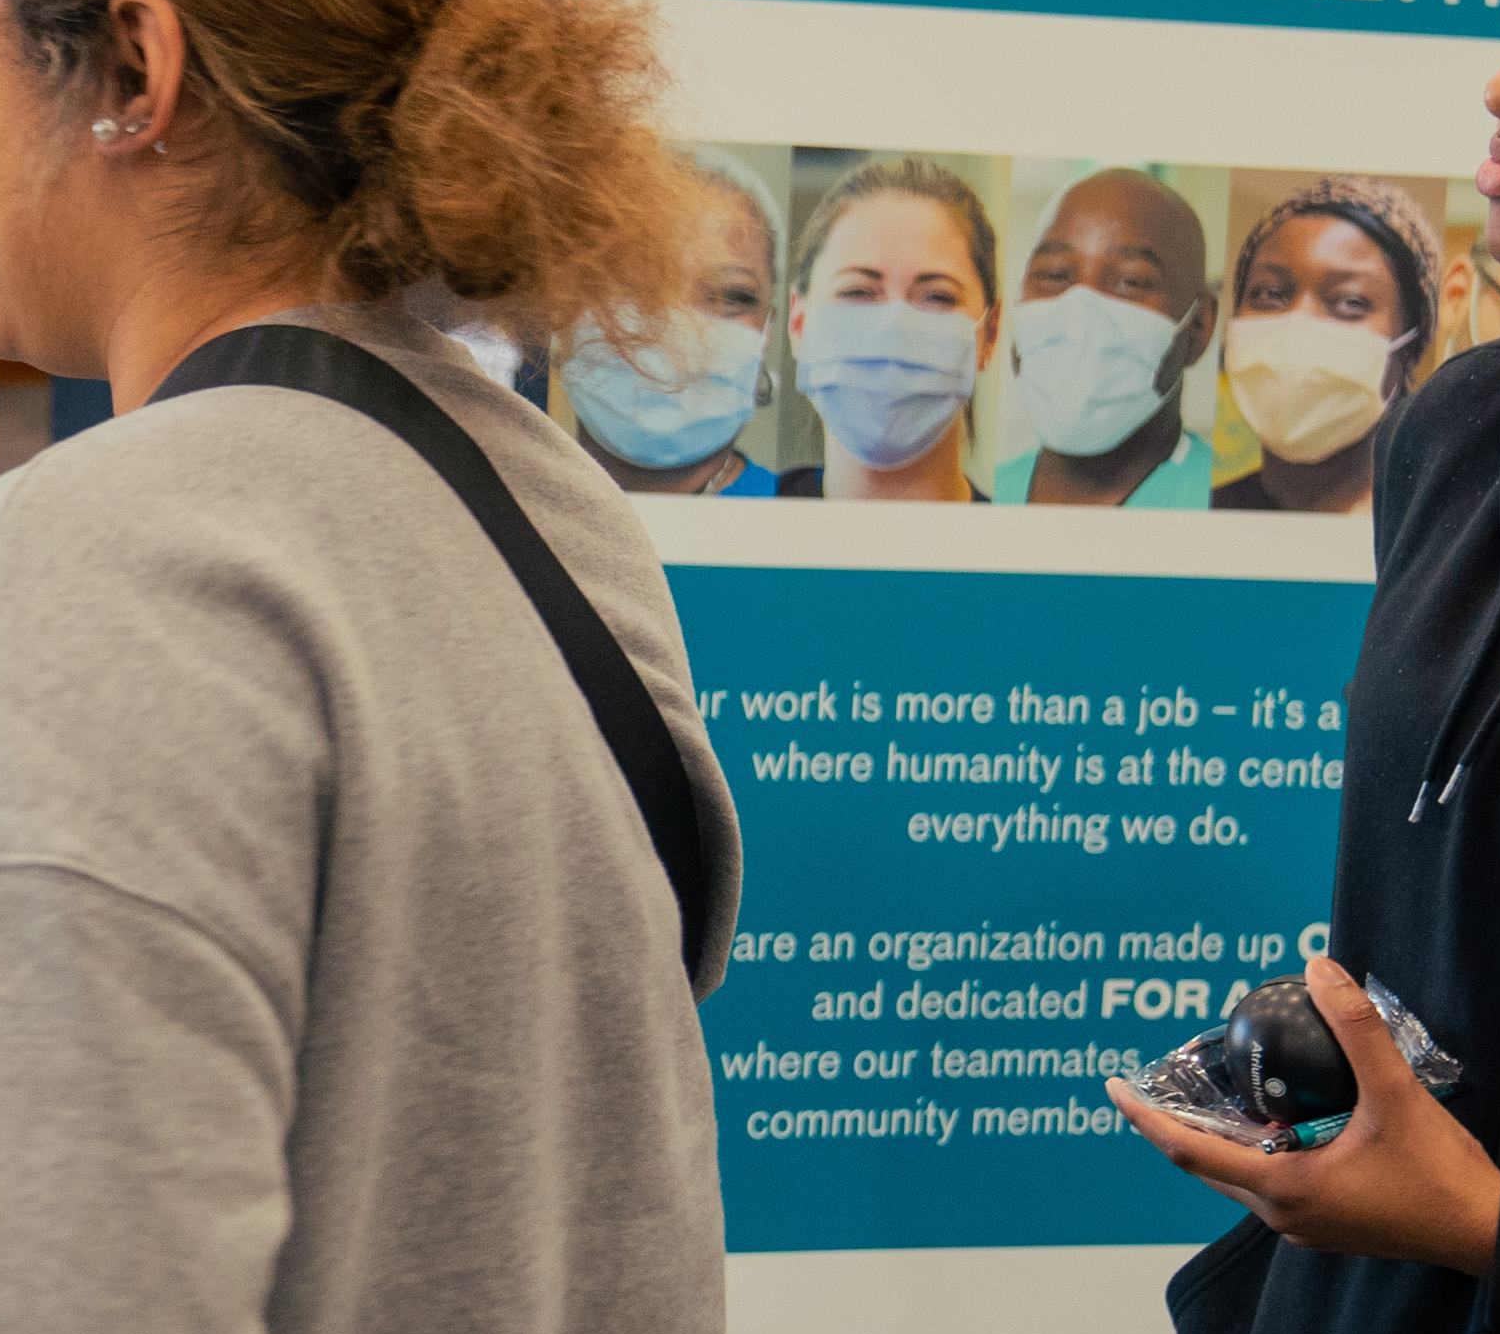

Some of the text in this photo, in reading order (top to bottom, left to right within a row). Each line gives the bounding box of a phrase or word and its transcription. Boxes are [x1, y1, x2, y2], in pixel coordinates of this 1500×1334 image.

[741, 681, 837, 722] work
[852, 681, 883, 723] is
[895, 693, 995, 724] more
[1008, 683, 1090, 725] than
[1102, 696, 1126, 726] a
[1136, 686, 1200, 736] job
[1317, 700, 1342, 731] a
[752, 741, 874, 783] where
[886, 742, 1062, 793] humanity
[1075, 744, 1106, 785] is
[1118, 749, 1155, 786] at
[1167, 746, 1227, 787] the
[908, 803, 1248, 854] everything we do.
[732, 932, 797, 962] are
[808, 932, 856, 962] an
[869, 921, 1105, 971] organization
[1119, 921, 1225, 962] made
[1238, 934, 1286, 971] up
[811, 980, 884, 1021] and
[896, 980, 1088, 1020] dedicated
[1101, 978, 1210, 1021] FOR
[721, 1041, 842, 1081] where
[854, 1050, 918, 1079] our
[747, 1095, 1141, 1145] community member
